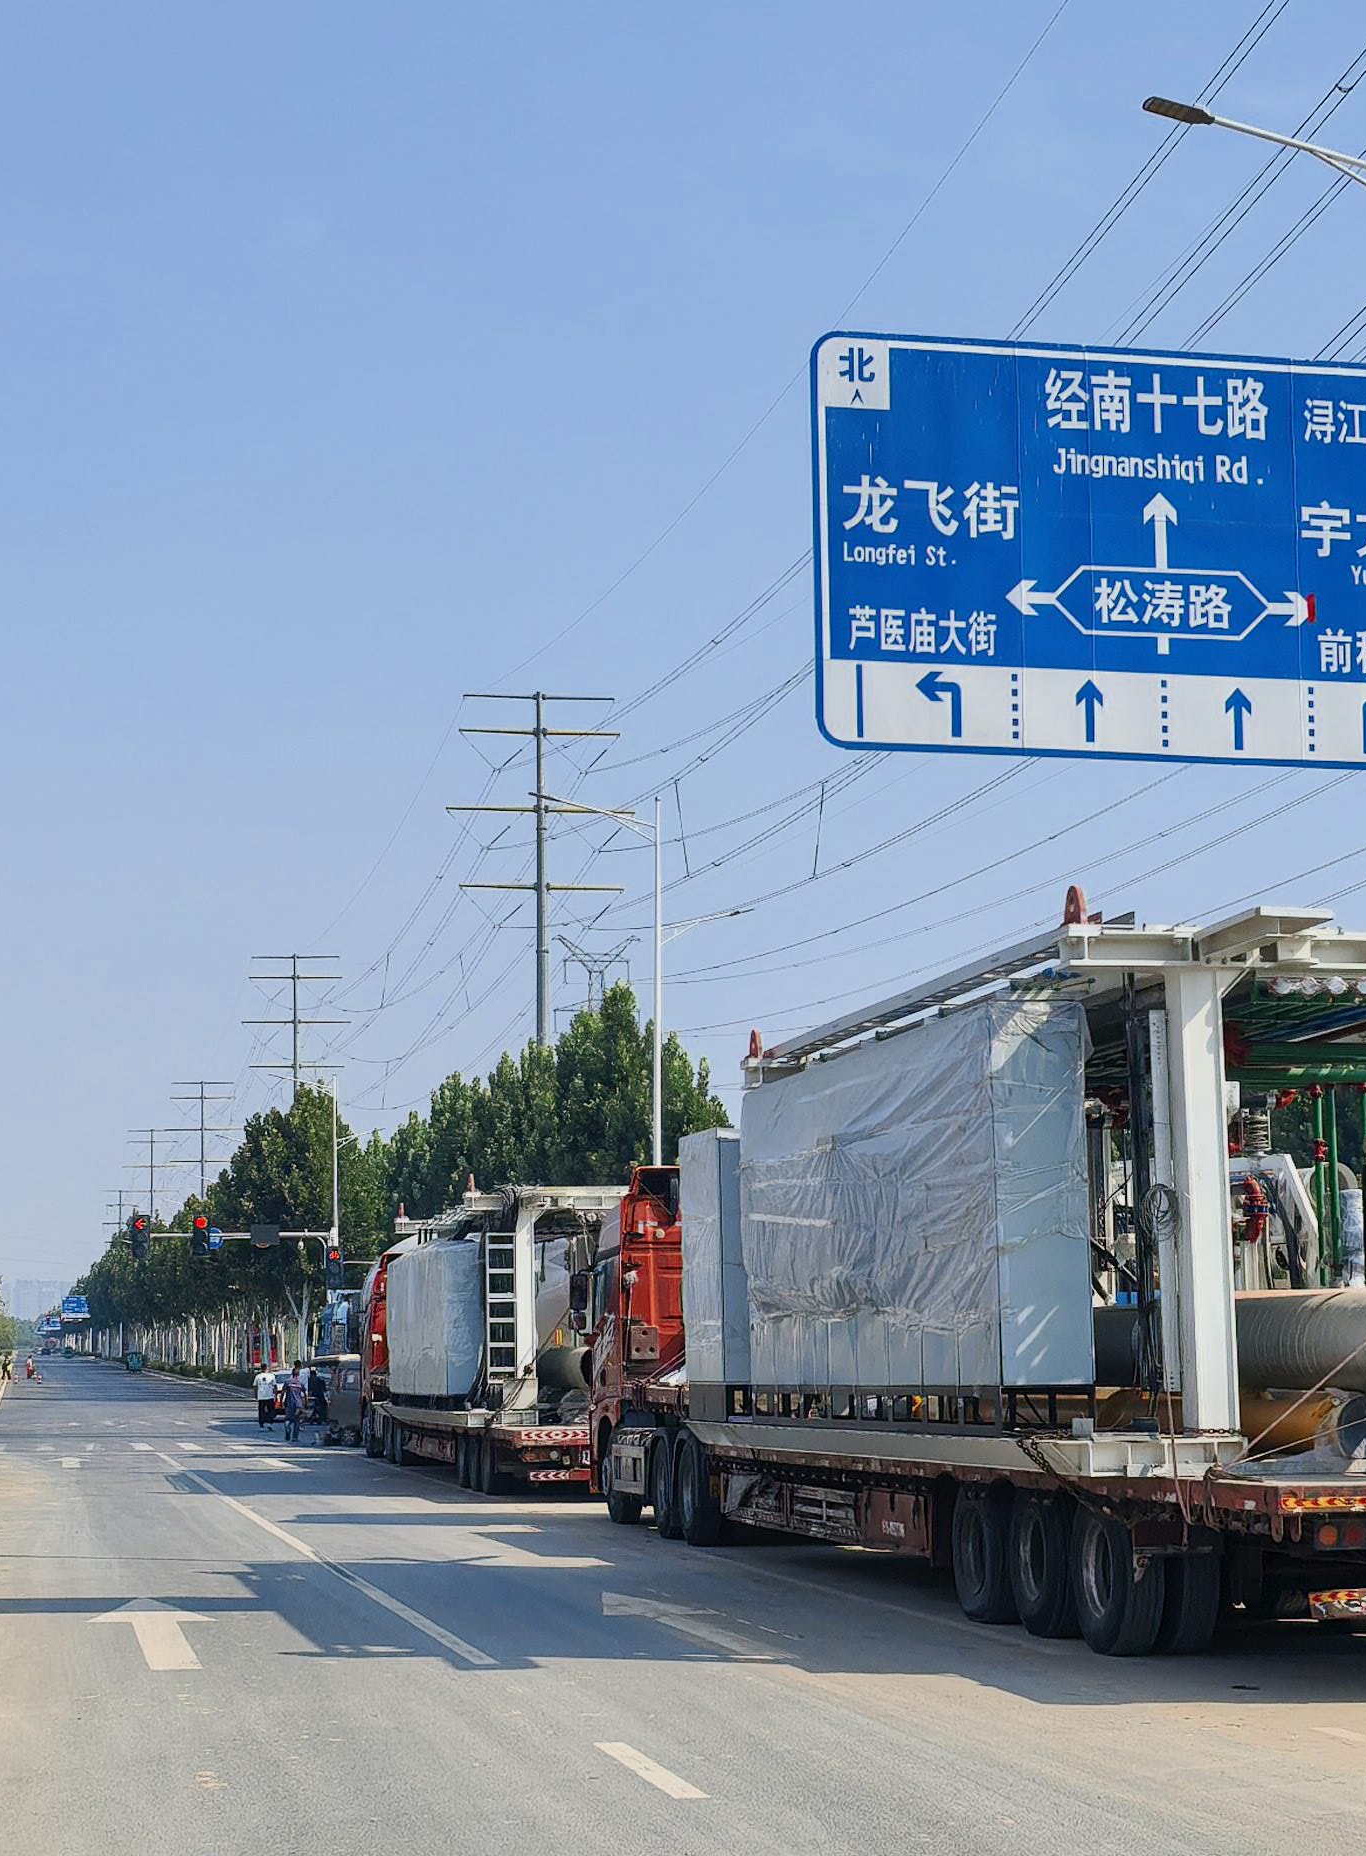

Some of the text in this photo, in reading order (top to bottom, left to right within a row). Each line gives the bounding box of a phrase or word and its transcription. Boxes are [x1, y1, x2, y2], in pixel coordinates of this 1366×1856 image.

[839, 347, 876, 382] 北
[1044, 367, 1269, 441] 经南十七路
[1053, 447, 1205, 485] Jingnanshiqi
[842, 474, 1020, 540] 龙飞街
[843, 542, 957, 567] Longfei St.
[1094, 577, 1233, 630] 松涛路
[848, 605, 998, 656] 芦医庙大街
